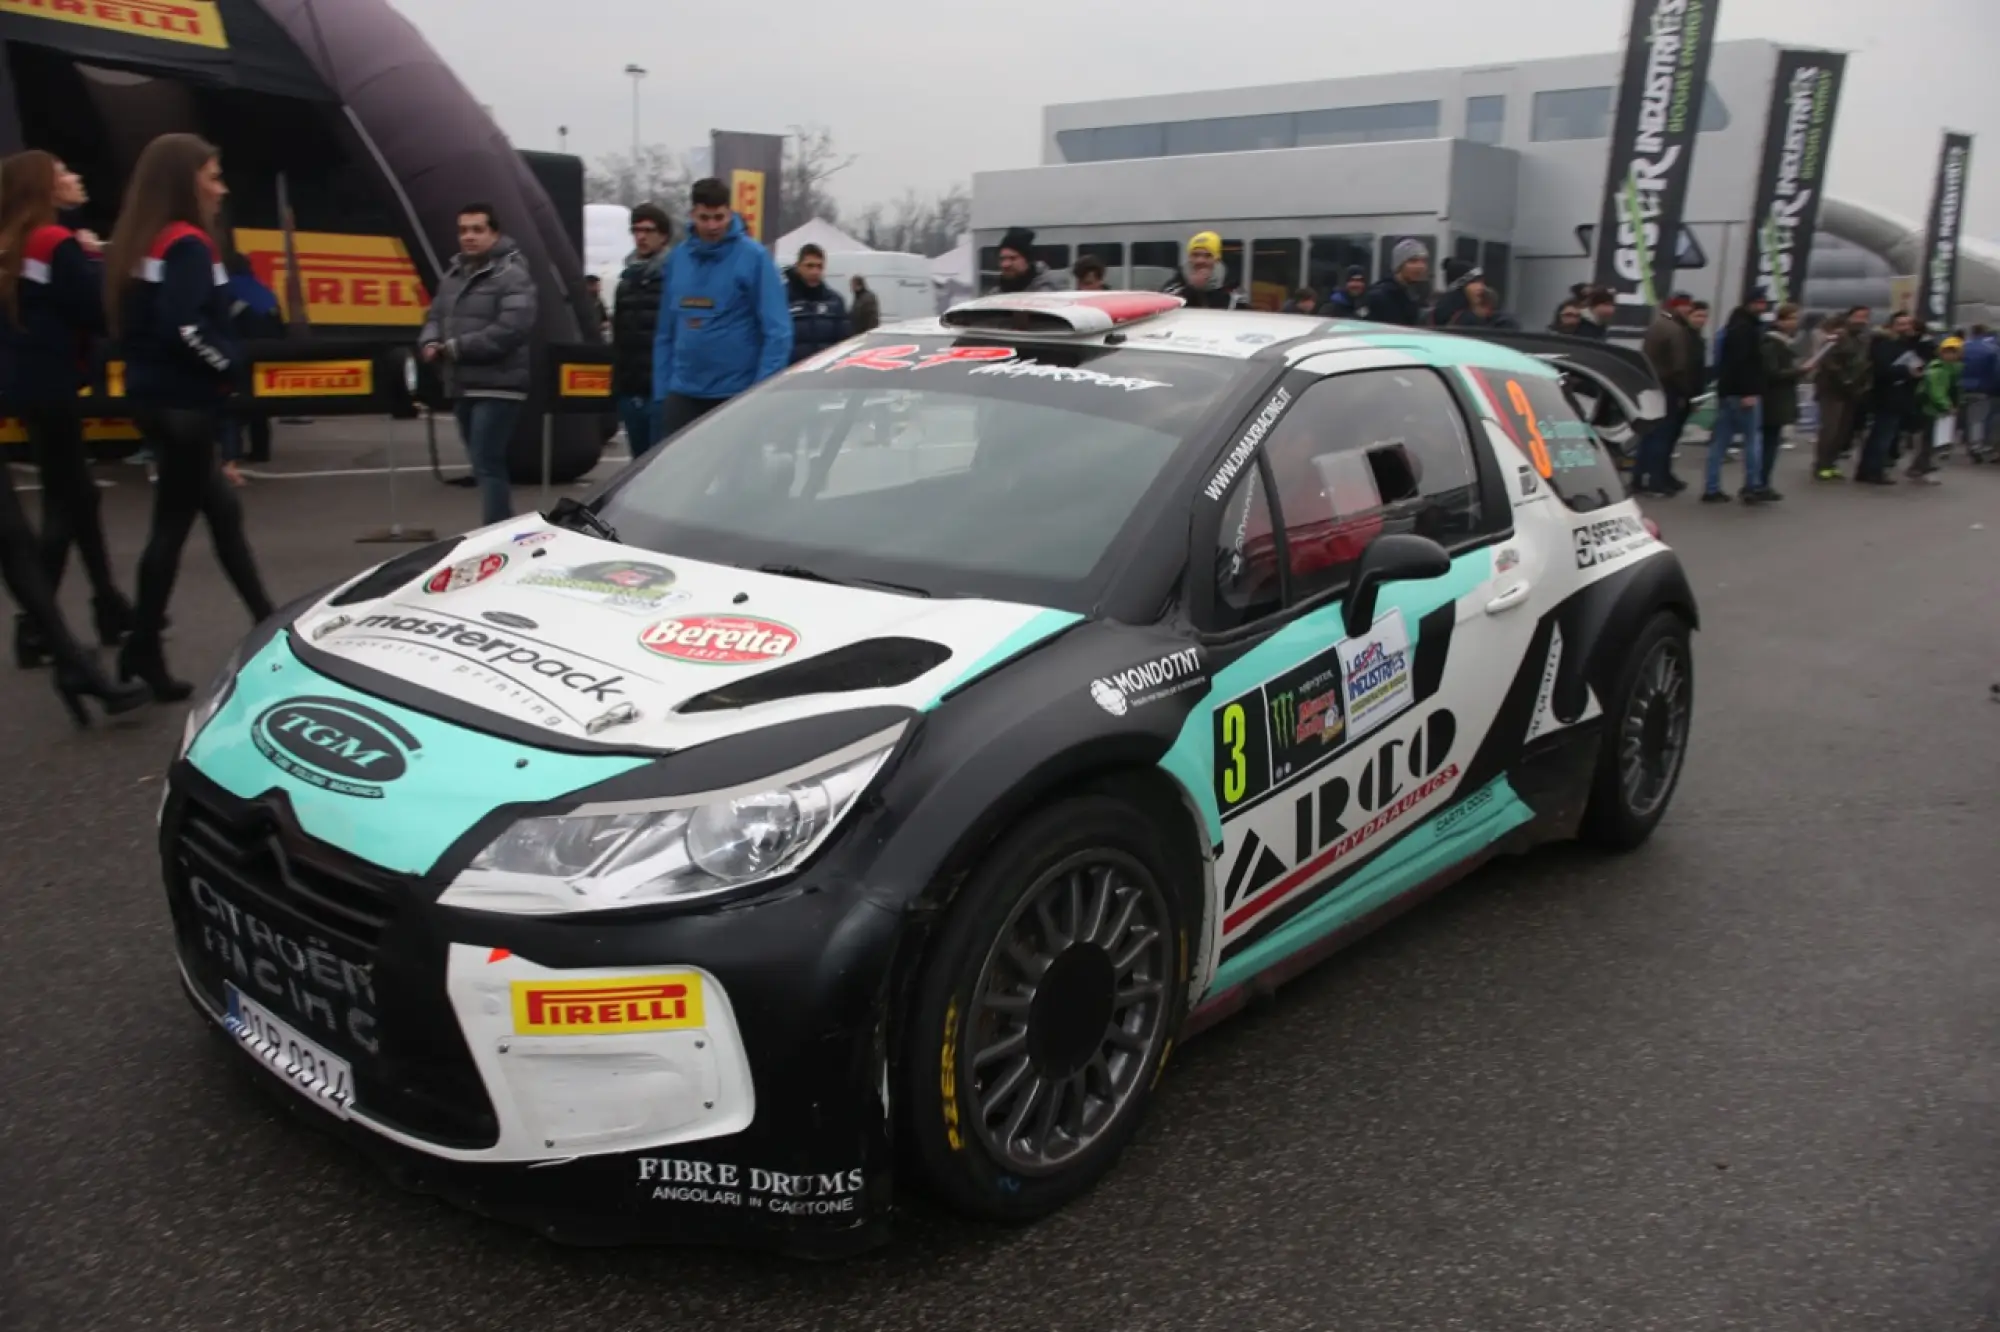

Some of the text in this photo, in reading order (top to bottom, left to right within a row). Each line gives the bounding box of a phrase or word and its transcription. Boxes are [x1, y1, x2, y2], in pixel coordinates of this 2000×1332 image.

[264, 367, 362, 390] PIRELLI
[1205, 387, 1292, 500] WWW.DMAXRACING.IT
[1506, 378, 1552, 478] 3
[355, 614, 623, 702] masterpack
[646, 620, 792, 656] Beretta
[452, 664, 562, 727] printing
[1113, 647, 1200, 695] MONDOTNT
[278, 714, 393, 768] TGM
[1223, 704, 1246, 803] 3
[1224, 709, 1456, 912] ARCO
[1335, 764, 1458, 858] HYDRAULICS
[526, 984, 687, 1025] PIRELLI
[638, 1157, 864, 1196] FIBRE DRUMS
[652, 1186, 853, 1215] ANGOLARI IN CARTONE
